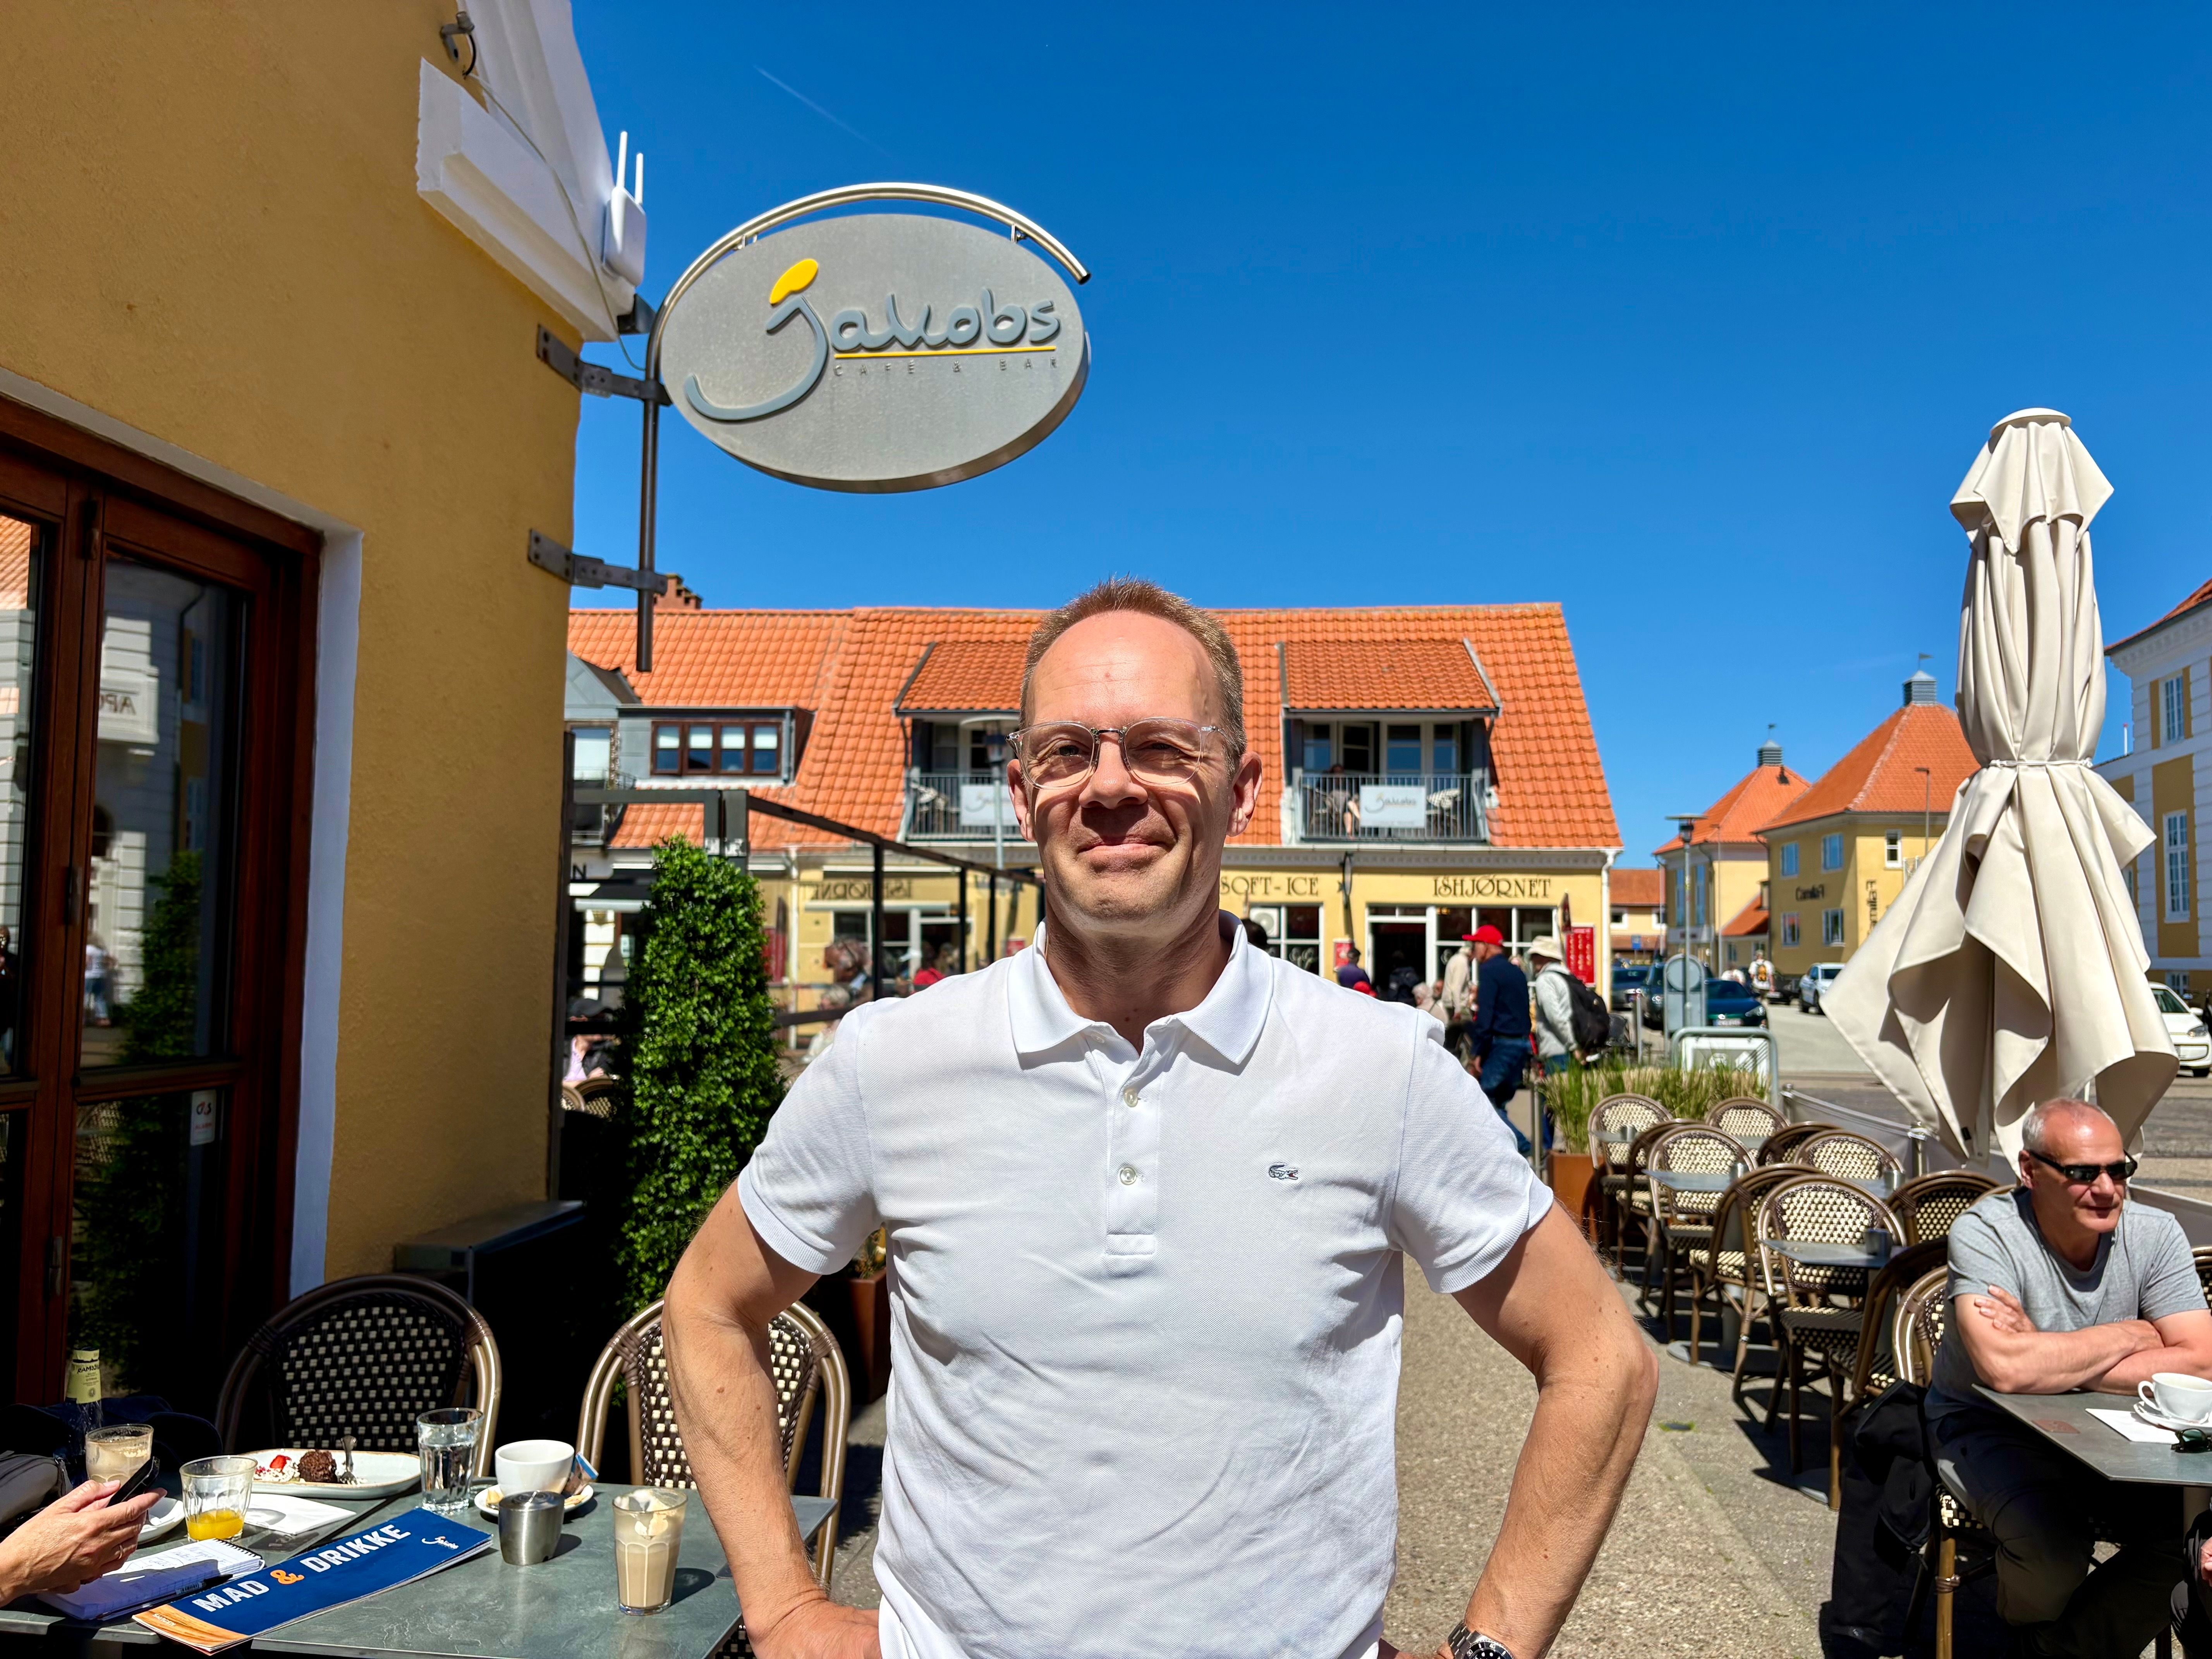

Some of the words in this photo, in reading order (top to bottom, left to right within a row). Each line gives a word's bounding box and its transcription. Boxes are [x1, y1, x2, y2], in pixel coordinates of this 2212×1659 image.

[952, 360, 962, 373] &
[999, 356, 1058, 371] BAR
[1433, 874, 1551, 898] ISHJØRNET
[192, 1580, 270, 1612] MAD
[270, 1570, 304, 1584] &
[300, 1525, 411, 1572] DRIKKE
